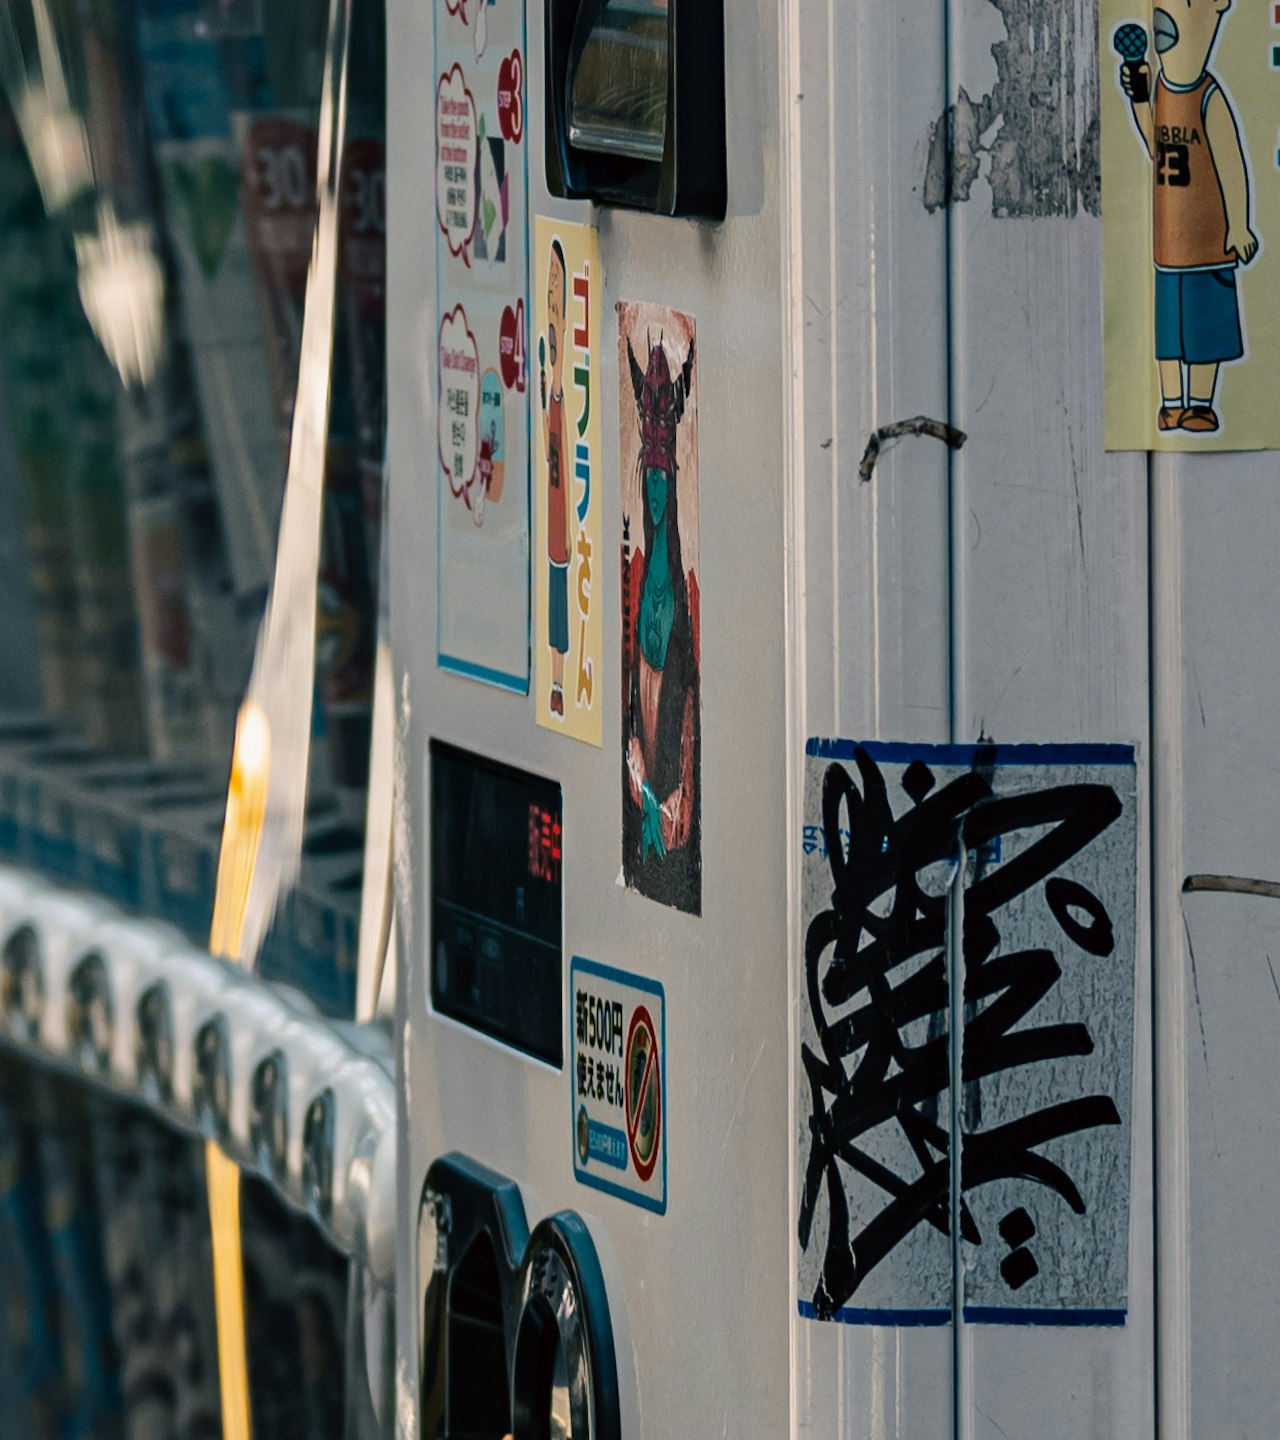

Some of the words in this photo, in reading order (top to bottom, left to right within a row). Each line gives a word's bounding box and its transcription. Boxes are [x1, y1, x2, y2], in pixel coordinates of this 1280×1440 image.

[511, 57, 522, 136] 3
[1155, 124, 1202, 145] BBLA
[514, 306, 524, 384] 4
[572, 263, 594, 712] ゴブラさん
[576, 988, 623, 1058] 新500円
[577, 1050, 624, 1108] 使えません
